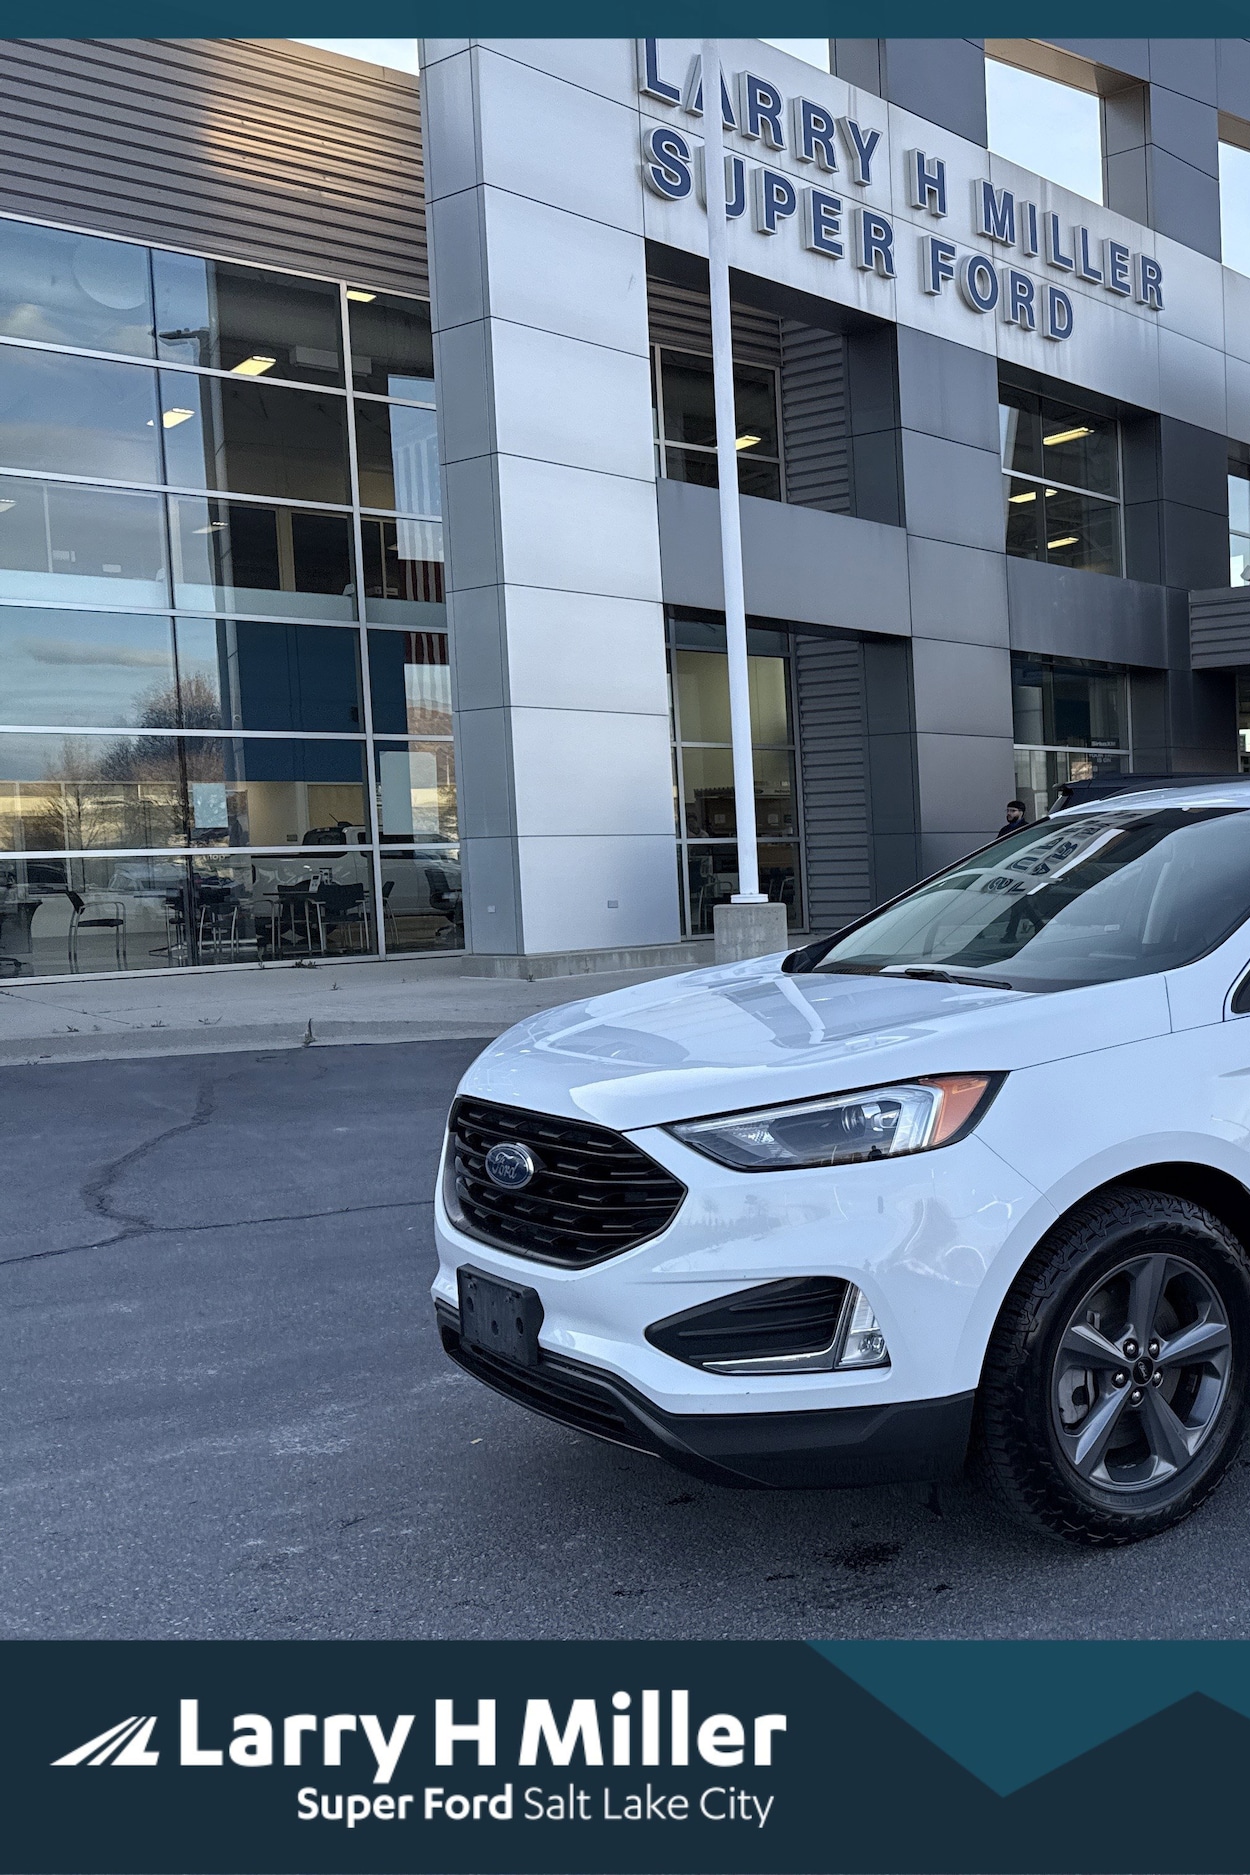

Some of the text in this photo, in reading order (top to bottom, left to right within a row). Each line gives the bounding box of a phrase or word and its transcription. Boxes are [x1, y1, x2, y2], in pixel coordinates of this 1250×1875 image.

[908, 148, 948, 218] H
[974, 178, 1166, 312] MILLER
[922, 235, 1074, 343] FORD
[492, 1151, 520, 1179] Ford
